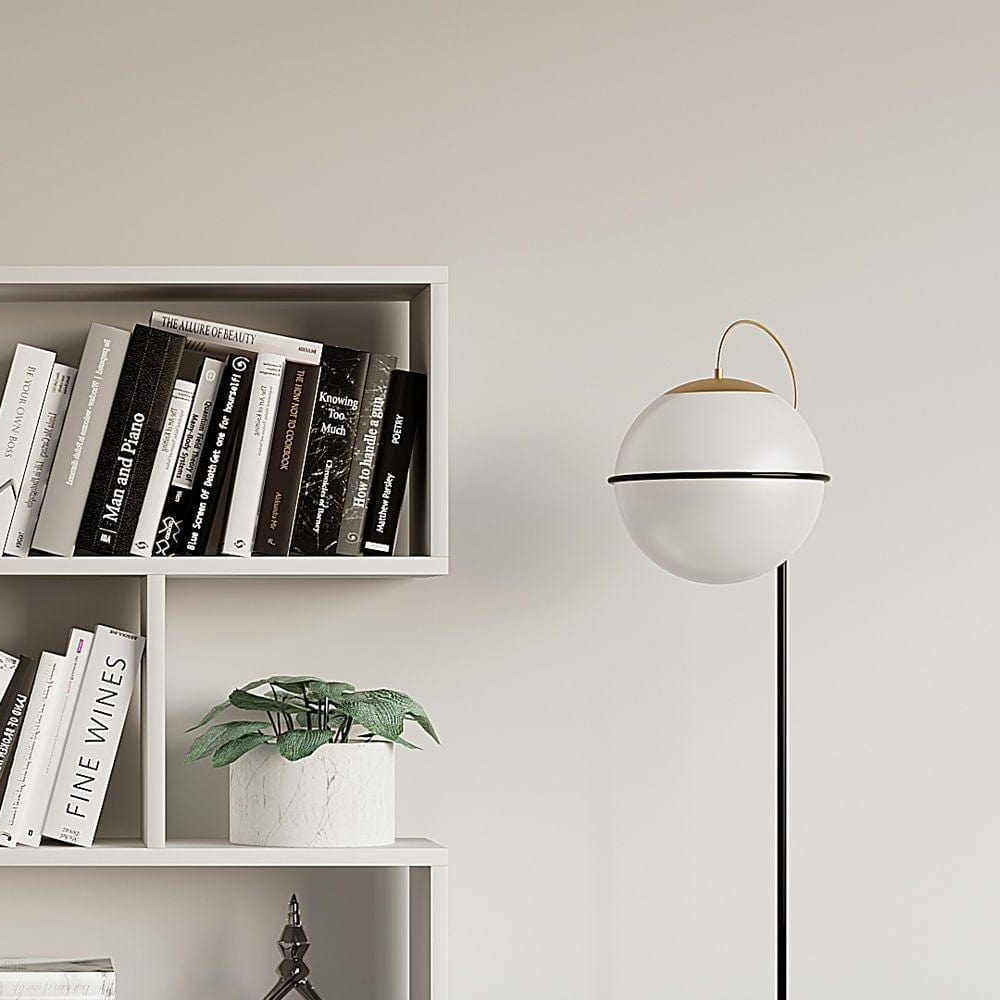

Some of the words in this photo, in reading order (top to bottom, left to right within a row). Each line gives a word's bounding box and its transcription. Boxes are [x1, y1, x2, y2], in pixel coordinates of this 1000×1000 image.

[162, 317, 177, 330] THE
[178, 321, 210, 336] ALLURE
[211, 327, 222, 338] OF
[223, 329, 256, 345] BEAUTY
[27, 366, 36, 376] BE
[295, 370, 305, 383] THE
[18, 380, 32, 404] YOUR
[293, 384, 302, 402] HOW
[317, 390, 359, 410] Knowing
[198, 399, 212, 432] Quantum
[290, 402, 299, 418] NOT
[326, 407, 346, 420] Too
[369, 395, 387, 420] gun
[12, 407, 24, 433] OWN
[180, 412, 199, 451] Many-Body
[219, 415, 229, 429] for
[288, 419, 296, 429] TO
[319, 421, 347, 436] Much
[368, 417, 380, 428] a
[391, 414, 404, 444] POETRY
[5, 435, 18, 457] BOSS
[121, 413, 145, 455] Piano
[193, 431, 204, 450] Field
[216, 432, 226, 447] one
[210, 449, 221, 464] Get
[280, 429, 294, 470] COOKBOOK
[357, 426, 379, 468] handle
[117, 456, 133, 486] and
[173, 450, 189, 479] Systems
[185, 448, 200, 473] Theory
[184, 472, 194, 482] of
[203, 464, 217, 487] Death
[319, 458, 333, 498] Chronicles
[356, 466, 371, 481] to
[380, 471, 396, 500] Parsley
[102, 489, 125, 522] Man
[200, 488, 210, 500] Of
[351, 479, 369, 509] How
[192, 502, 207, 529] Screen
[311, 506, 324, 534] Barney
[373, 498, 391, 534] Matthew
[186, 532, 199, 550] Blue
[66, 756, 100, 818] FINE
[85, 656, 126, 742] WINES
